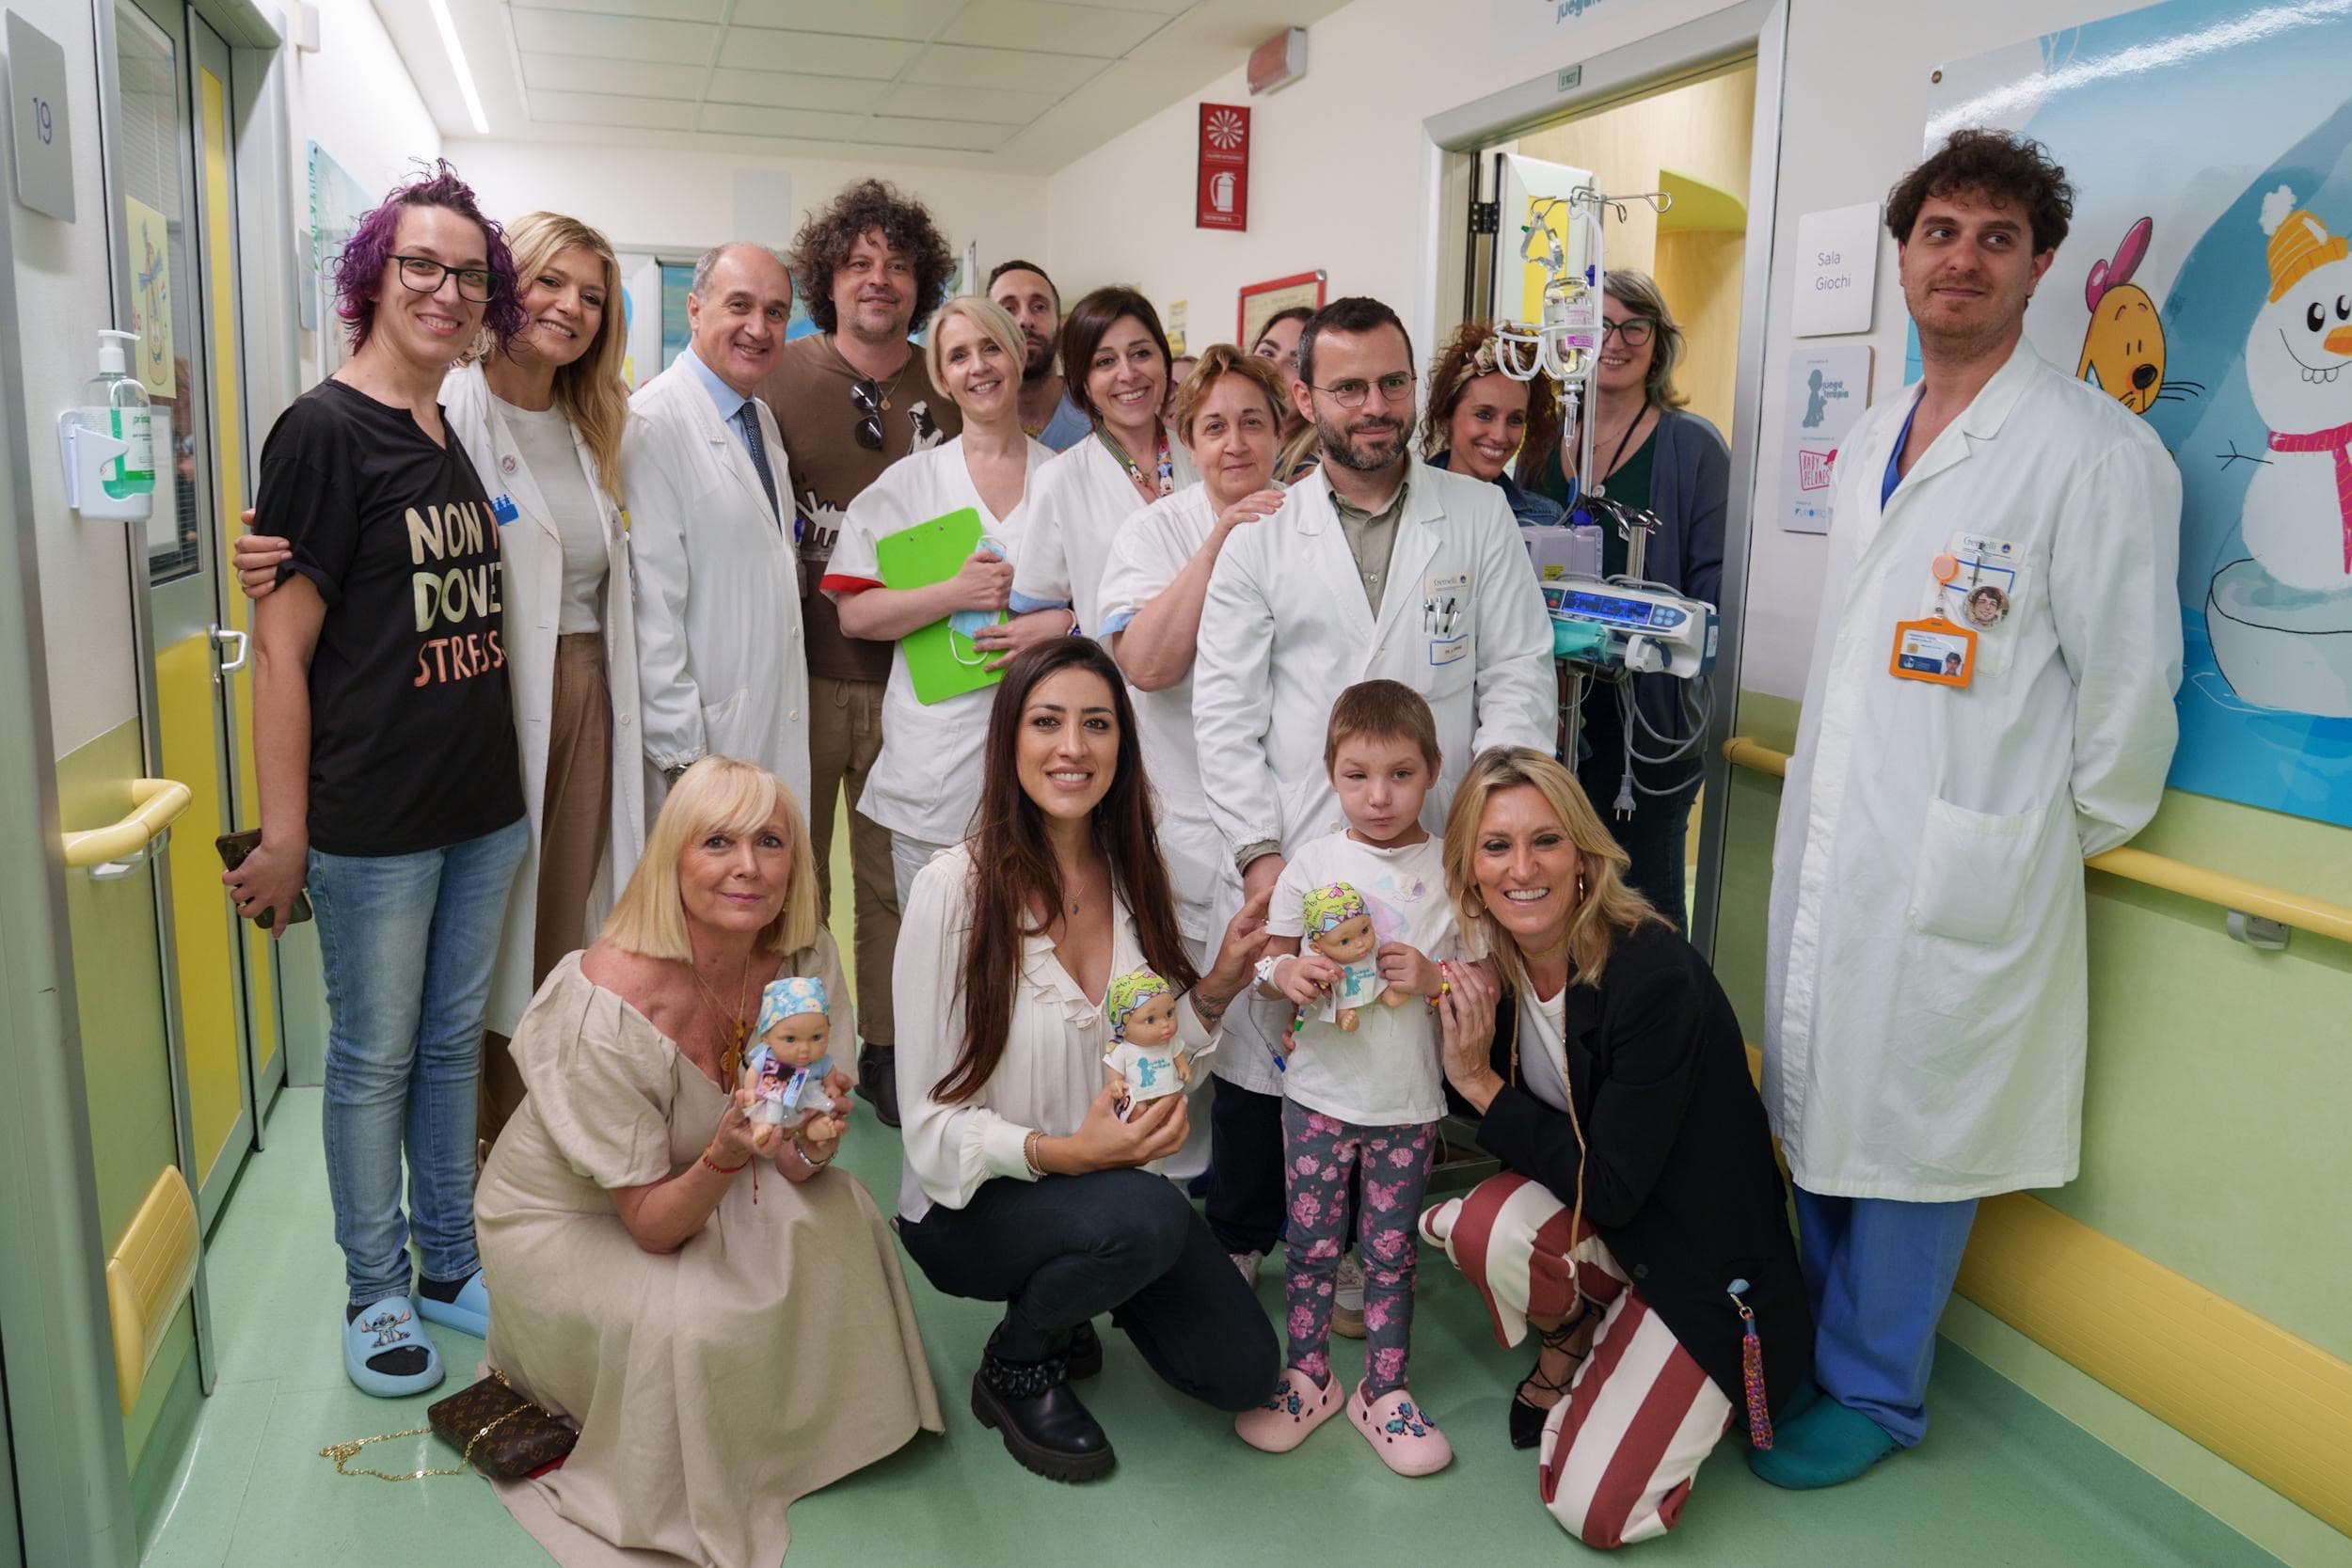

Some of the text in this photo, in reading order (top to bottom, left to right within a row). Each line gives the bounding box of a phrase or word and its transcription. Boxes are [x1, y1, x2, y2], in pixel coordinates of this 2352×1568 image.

[33, 97, 53, 145] 19
[1817, 250, 1841, 266] Sala
[1816, 274, 1851, 291] Giochi
[405, 501, 484, 564] NON
[1963, 535, 1997, 549] Geelli
[412, 562, 502, 632] DOVE
[413, 629, 507, 688] STRESS
